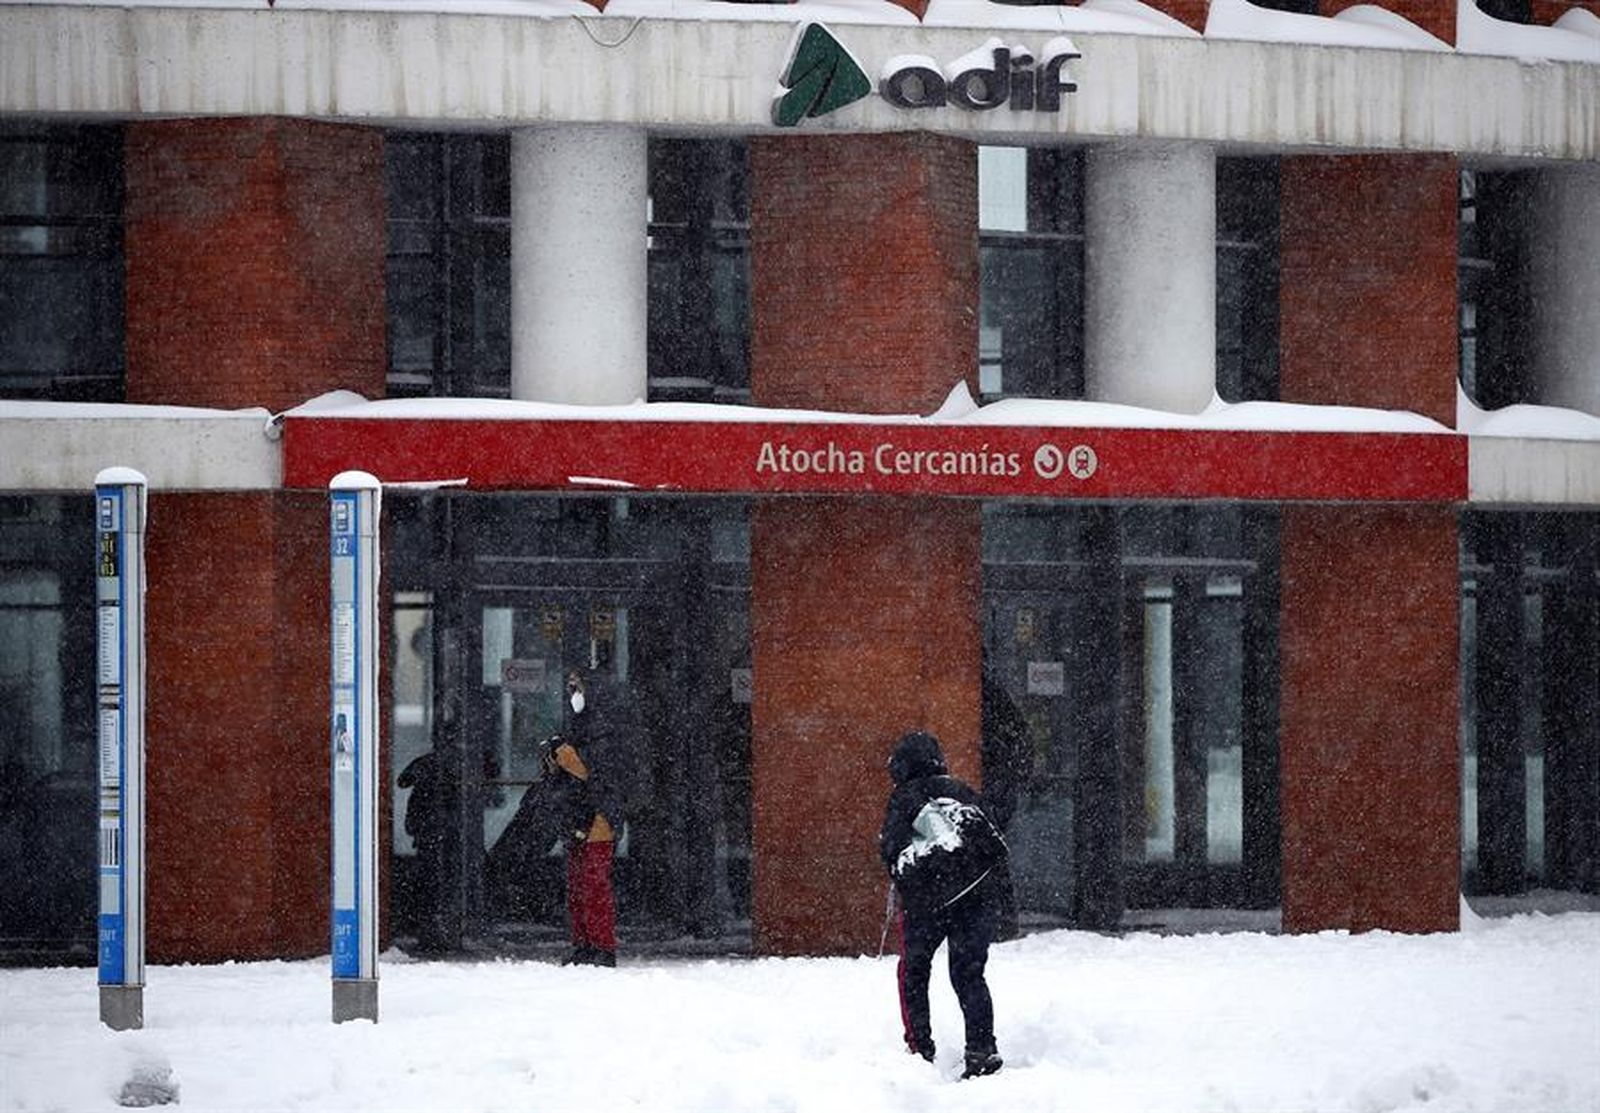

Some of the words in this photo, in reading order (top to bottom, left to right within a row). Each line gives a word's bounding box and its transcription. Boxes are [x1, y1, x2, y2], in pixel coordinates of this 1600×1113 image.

[878, 48, 1081, 111] adif
[755, 441, 866, 474] Atocha
[875, 443, 1021, 477] Cercanías
[336, 537, 349, 555] 32
